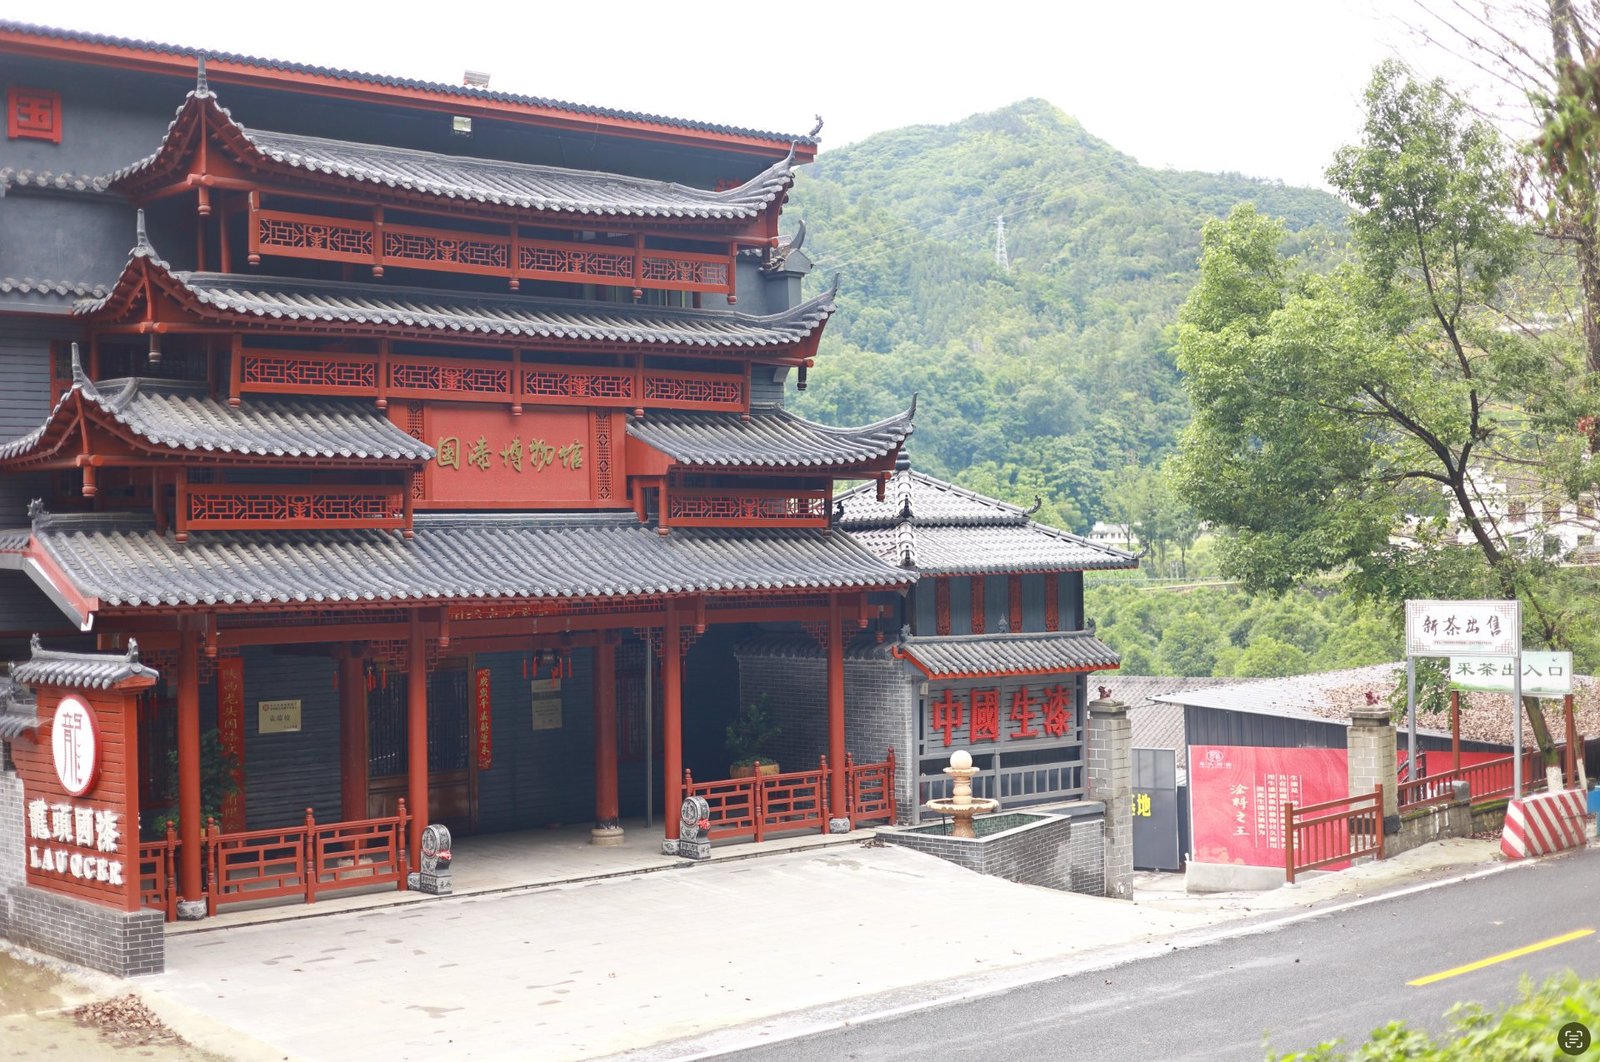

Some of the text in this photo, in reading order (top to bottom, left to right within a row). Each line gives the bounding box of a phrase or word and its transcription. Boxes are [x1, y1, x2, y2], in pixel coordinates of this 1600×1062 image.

[437, 435, 584, 473] 国漆博物馆
[1423, 615, 1502, 637] 新茶出售
[1455, 663, 1563, 677] 采茶出入口
[932, 685, 1071, 747] 中國生漆
[1132, 793, 1151, 816] 地
[1230, 783, 1250, 836] 涂料之王
[28, 798, 121, 853] 龍頭國漆
